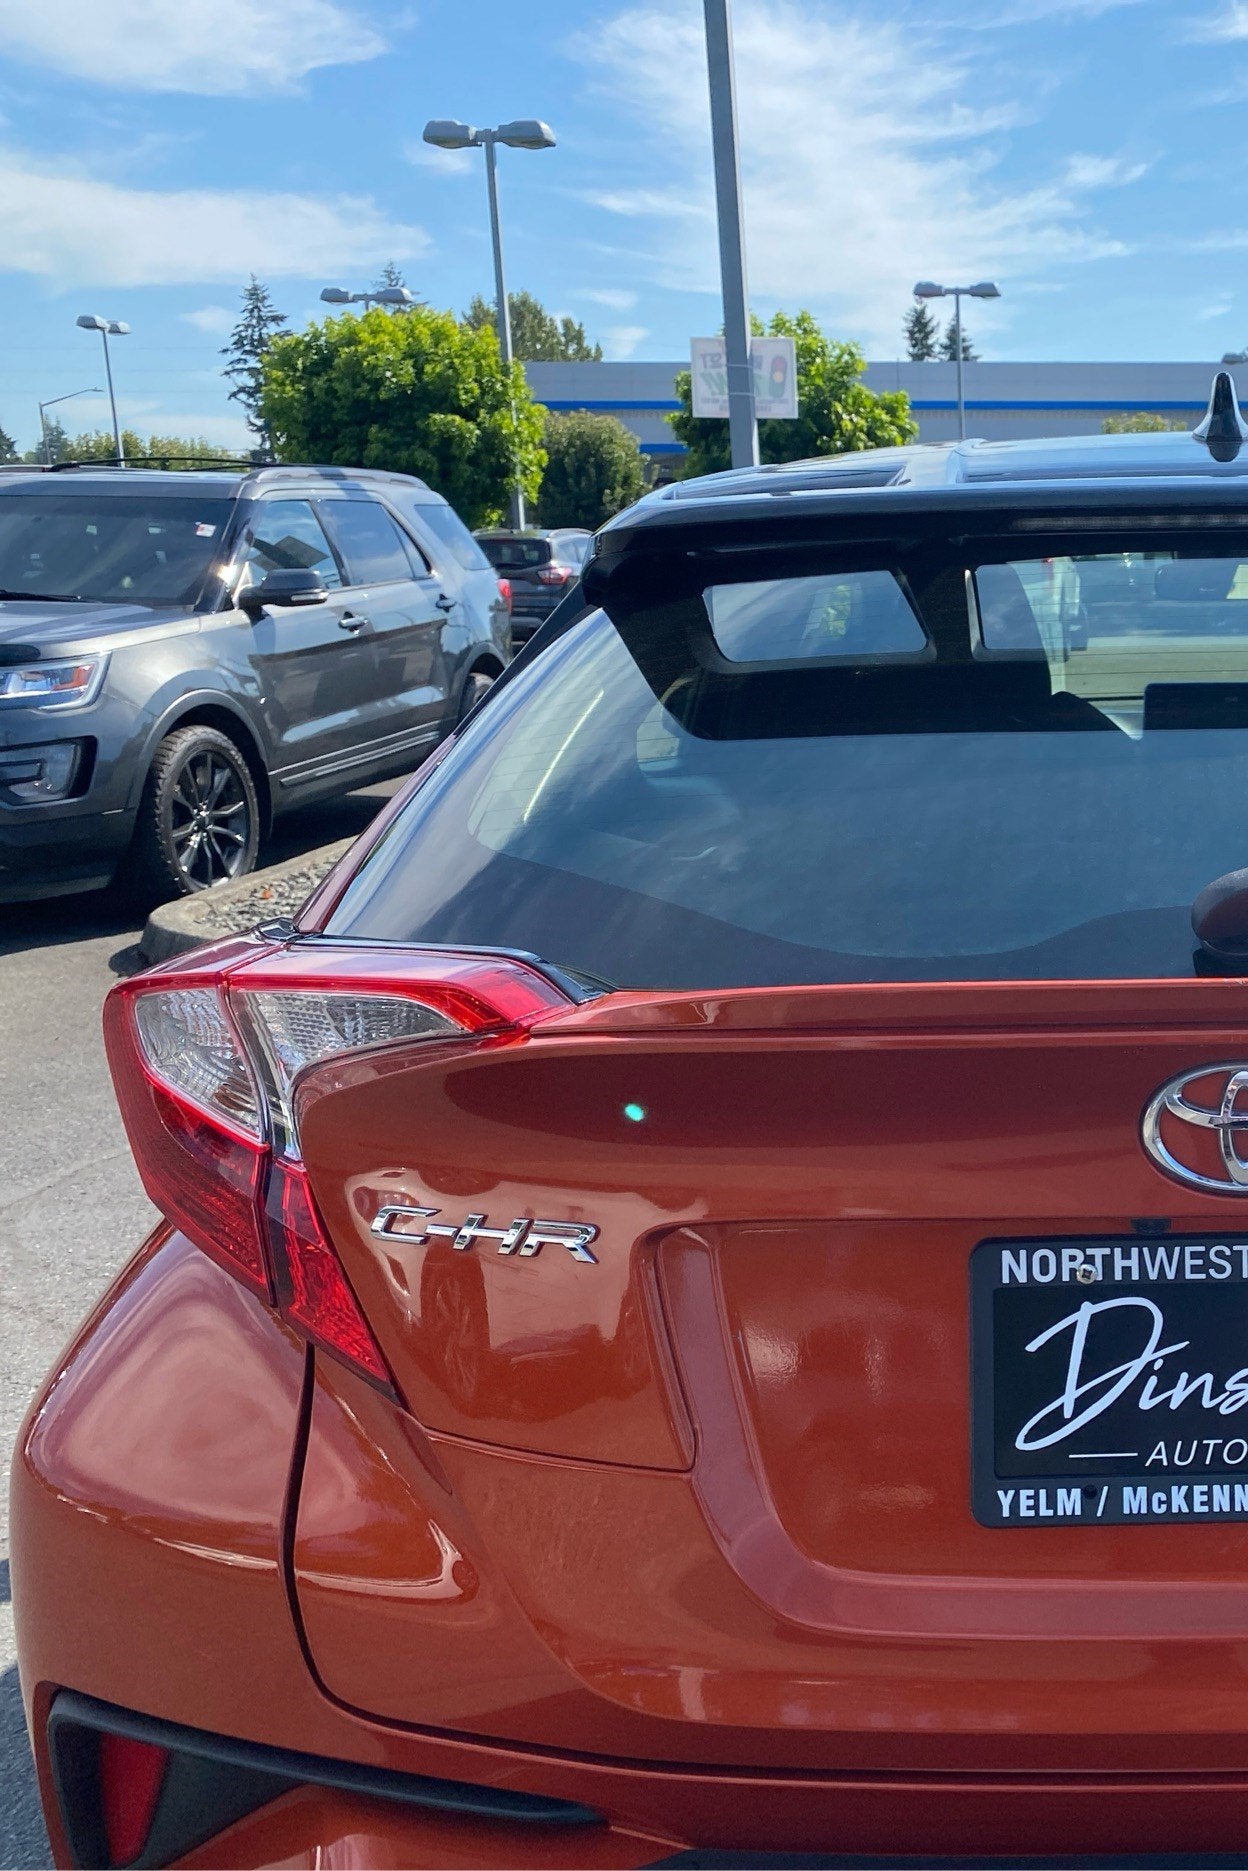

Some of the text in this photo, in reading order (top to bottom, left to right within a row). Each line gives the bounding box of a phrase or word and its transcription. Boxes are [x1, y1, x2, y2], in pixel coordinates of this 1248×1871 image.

[370, 1204, 600, 1265] C-HR
[1145, 1438, 1248, 1467] AUTO
[997, 1487, 1082, 1518] YELM
[1096, 1485, 1107, 1517] /
